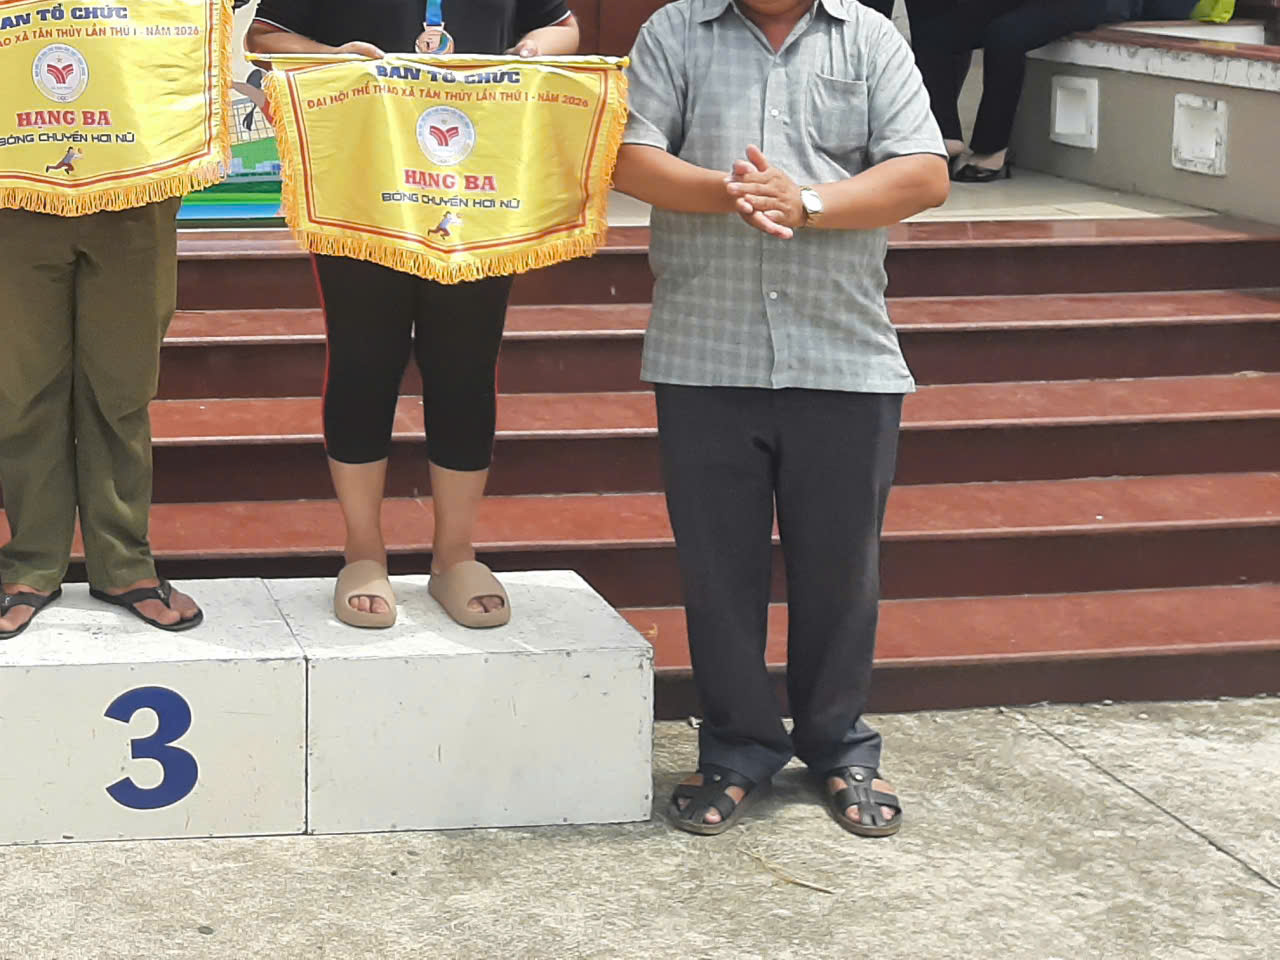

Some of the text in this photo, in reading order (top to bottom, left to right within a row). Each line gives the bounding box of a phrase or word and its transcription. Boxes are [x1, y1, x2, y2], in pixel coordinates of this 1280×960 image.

[36, 3, 64, 21] TỔ
[70, 5, 128, 19] CHỨC
[15, 31, 29, 43] XÃ
[32, 27, 52, 39] TÂN
[174, 26, 199, 36] 2026
[376, 65, 421, 80] BAN
[307, 98, 327, 110] ĐẠI
[562, 95, 588, 107] 2026
[16, 110, 112, 129] HẠNG BA
[404, 169, 497, 191] HẠNG BA
[382, 191, 419, 202] BÓNG
[104, 685, 199, 810] 3
